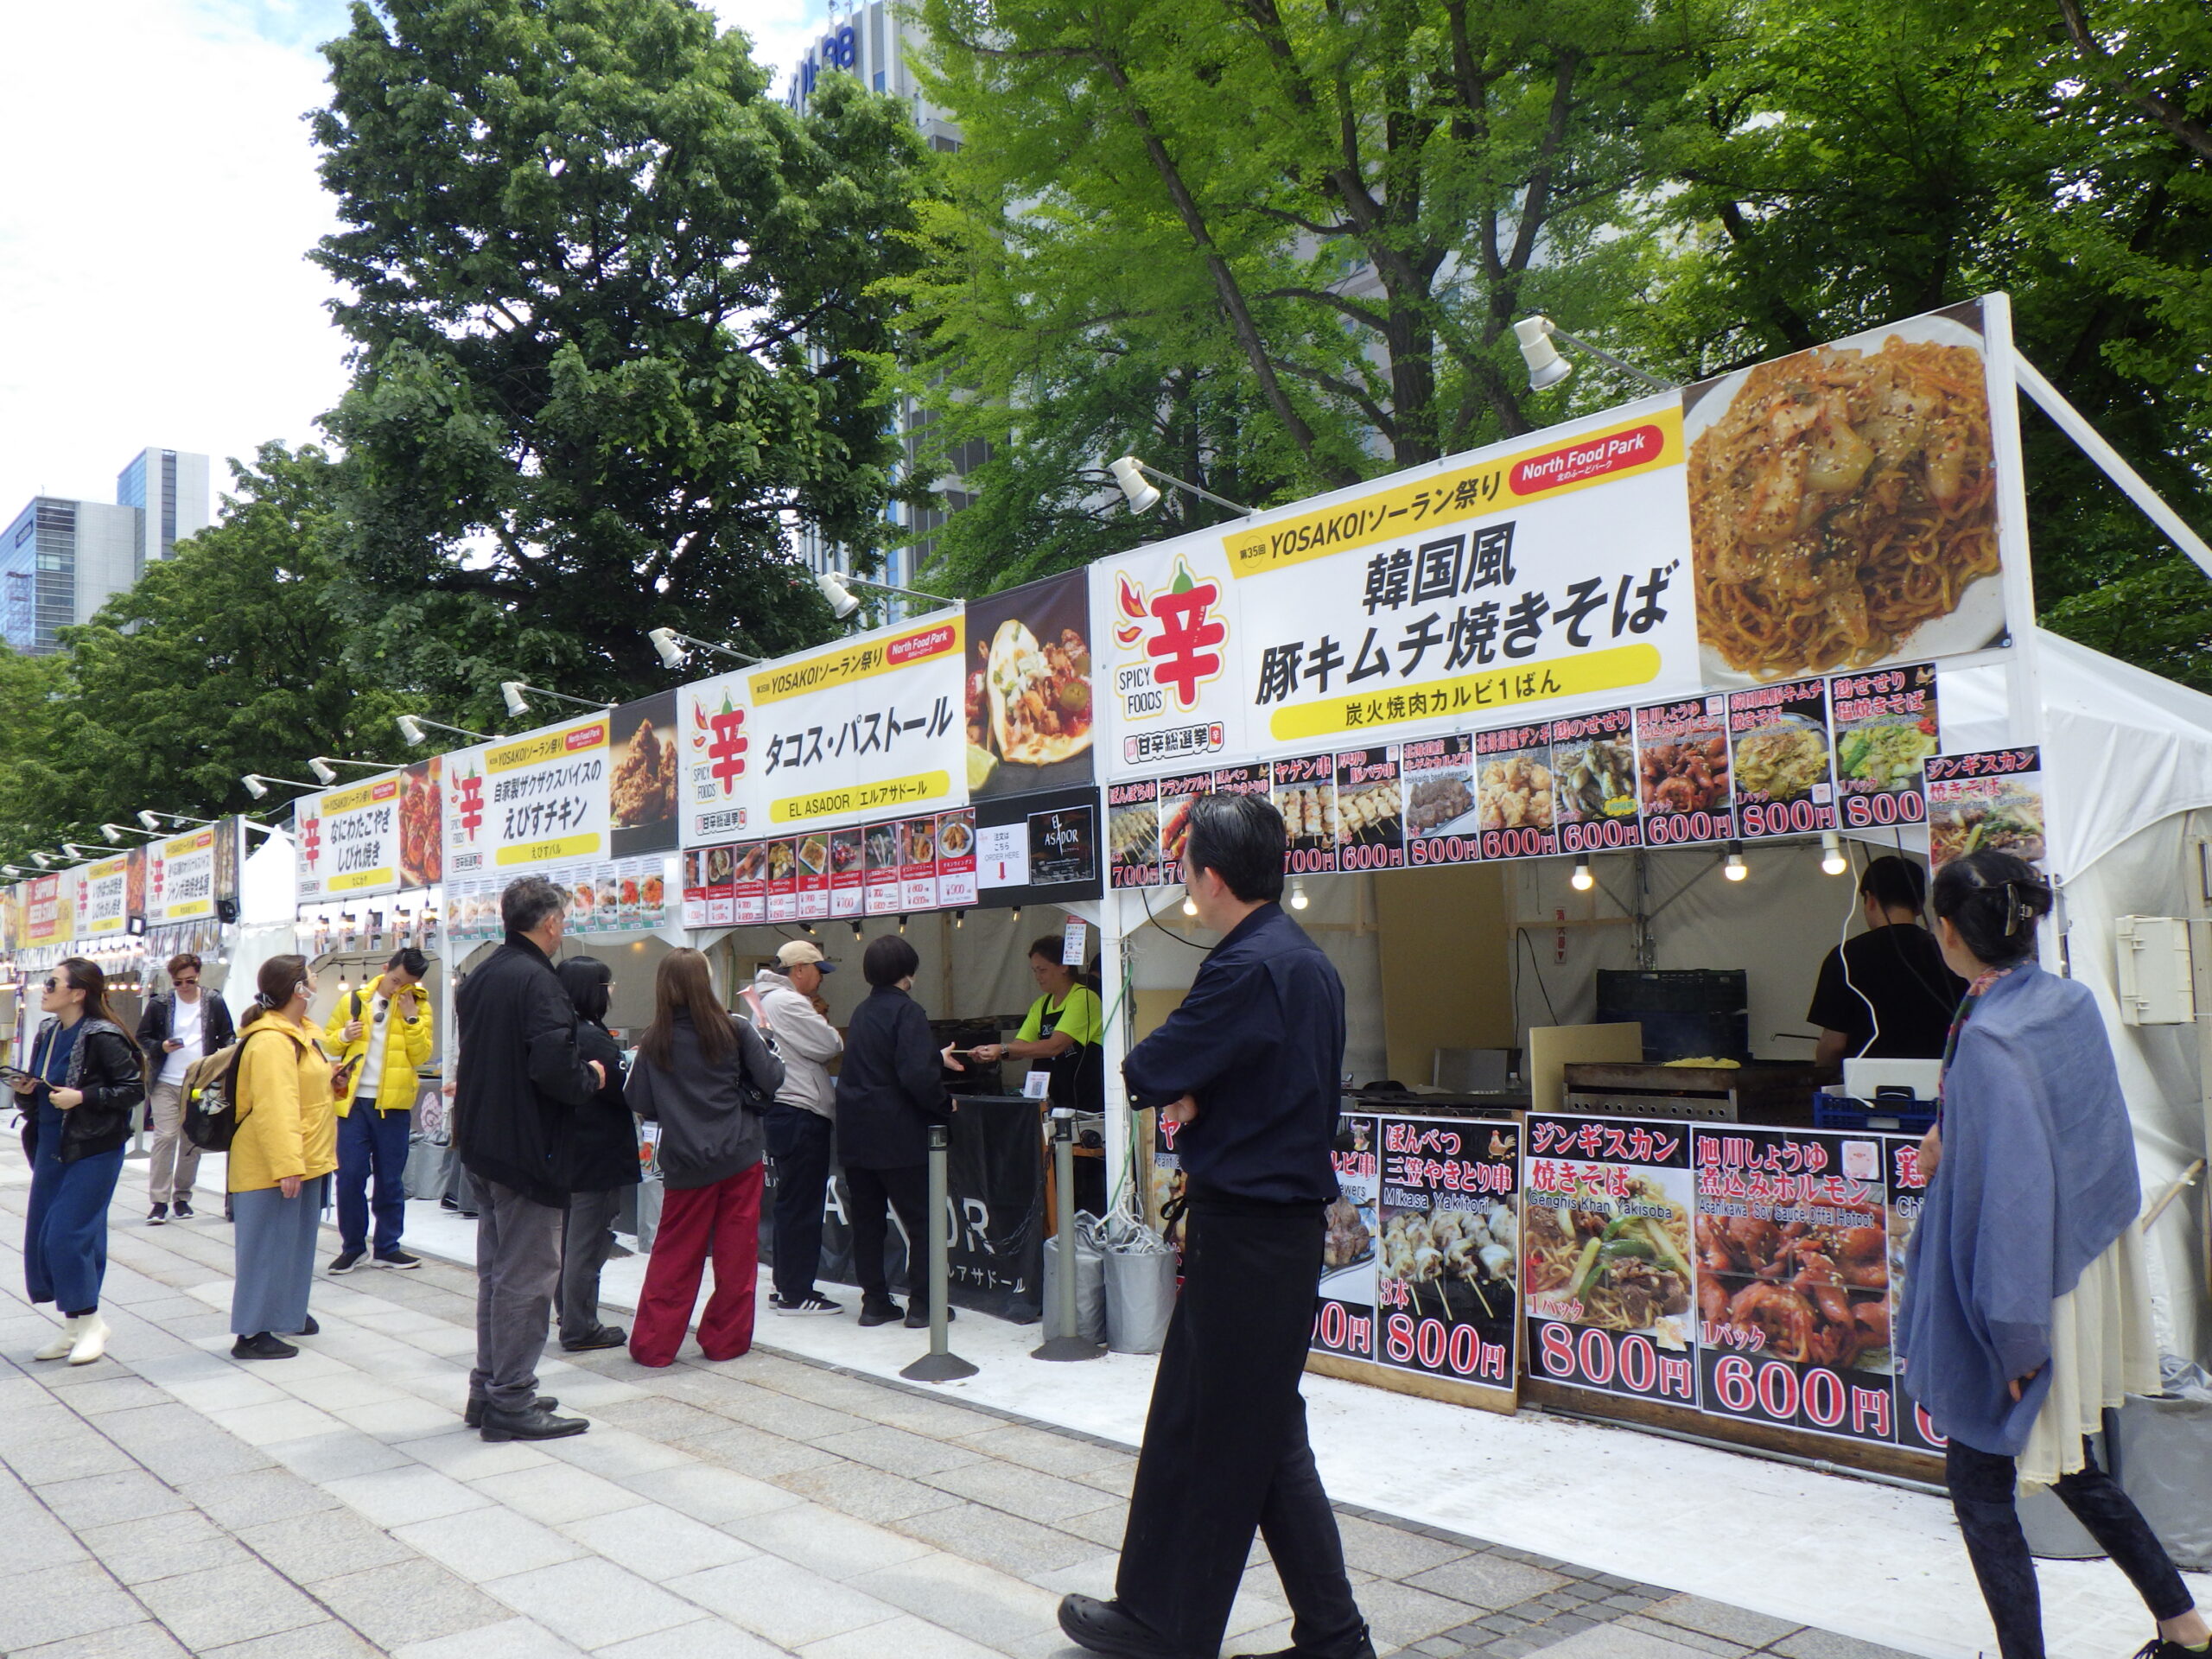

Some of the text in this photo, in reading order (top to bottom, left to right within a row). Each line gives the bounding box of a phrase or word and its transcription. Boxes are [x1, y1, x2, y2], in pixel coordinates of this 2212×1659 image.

[1522, 433, 1645, 481] North Food Park
[1239, 470, 1501, 561] 第35回 YOSAKOIソーラン祭り
[1362, 520, 1517, 616] 韓国風
[892, 631, 948, 655] North Food Park
[1255, 558, 1681, 705] 豚キムチ焼きそば
[772, 646, 883, 695] YOSAKOIソーラン祭り
[1119, 667, 1150, 690] SPICY
[1834, 671, 1906, 700] 鶏せせり
[1128, 690, 1162, 714] FOODS
[1344, 669, 1561, 727] 炭火焼肉カルビ1ばん
[1731, 680, 1824, 712] 韓国風豚キムチ
[1835, 689, 1926, 721] 塩焼きそば
[1553, 709, 1630, 741] 鶏のせせり
[1731, 706, 1783, 732] 焼きそば
[498, 737, 564, 766] YOSAKOIソーラン祭り
[766, 696, 954, 777] タコス・パストール
[1138, 727, 1208, 755] 甘辛総選挙
[1404, 739, 1446, 760] 北海道産
[1476, 724, 1551, 754] 北海道塩ザンギ
[694, 766, 710, 782] SPICY
[1274, 755, 1332, 784] ヤゲン串
[1350, 761, 1395, 784] 豚バラ串
[1926, 750, 2036, 780] ジンギスカン
[697, 784, 716, 799] FOODS
[789, 781, 927, 817] EL ASADOR エルアサドール
[1160, 774, 1211, 796] フランクフルト
[1929, 776, 2002, 803] 焼きそば
[503, 796, 588, 841] えびすチキン
[1743, 798, 1837, 838] 800円
[1846, 790, 1924, 827] 800
[330, 806, 391, 844] なにわたこやき
[1045, 829, 1079, 847] ASADOR
[1563, 818, 1640, 852] 600円
[1648, 810, 1733, 845] 600円
[338, 840, 381, 872] しびれ焼き
[985, 851, 1020, 861] ORDER HERE
[1342, 842, 1403, 871] 600円
[1411, 835, 1479, 865] 800円
[1483, 827, 1555, 859] 600円
[1532, 1122, 1680, 1163] ジンギスカン
[1697, 1135, 1828, 1173] 旭川しょうゆ
[1385, 1155, 1513, 1196] 三笠やきとり串
[1532, 1159, 1630, 1198] 焼きそば
[1698, 1166, 1872, 1206] 煮込みホルモン
[1383, 1187, 1490, 1214] Mikasa Yakitori
[1529, 1192, 1673, 1219] Genghis Khan Yakisoba
[1698, 1199, 1874, 1229] Asahikawa Soy Sauce Offal Hotpot
[1380, 1277, 1410, 1311] 3本
[1530, 1293, 1585, 1323] 1パック
[1386, 1313, 1507, 1381] 800円
[1701, 1321, 1765, 1352] 1パック
[1541, 1321, 1692, 1399] 800円
[1714, 1355, 1891, 1437] 600円
